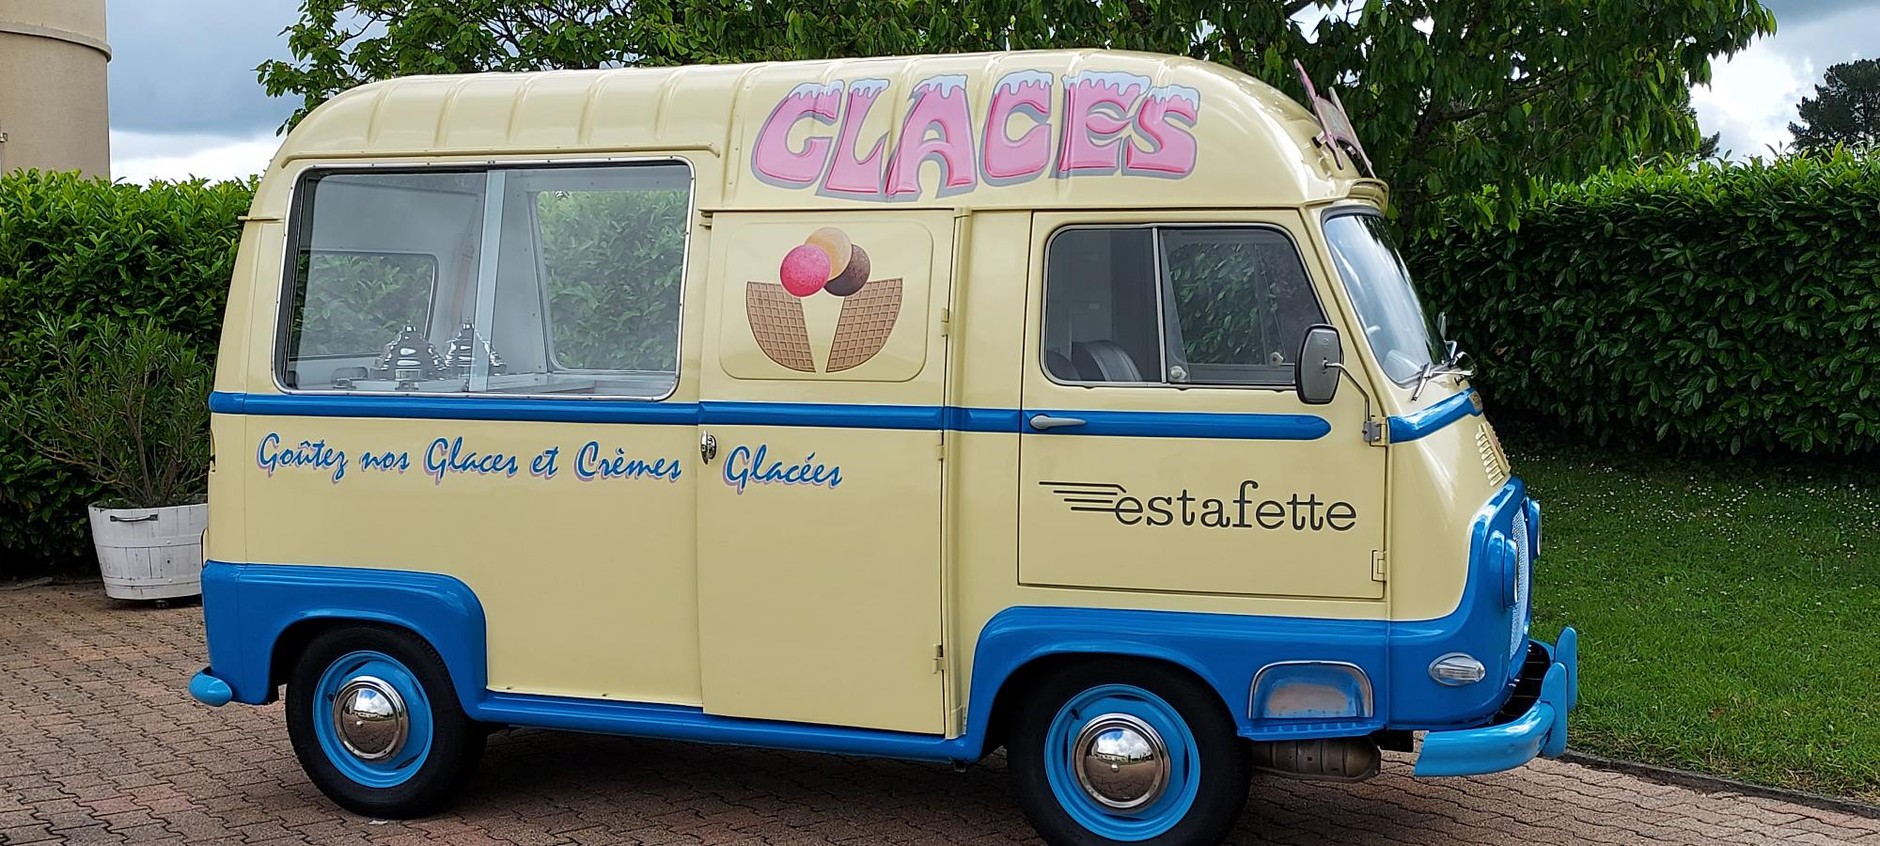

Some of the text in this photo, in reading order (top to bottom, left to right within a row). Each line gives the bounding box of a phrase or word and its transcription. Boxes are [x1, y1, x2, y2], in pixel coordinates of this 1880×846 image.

[751, 70, 1201, 202] GLACES
[257, 432, 843, 494] Goûtez nos Glaces et Crèmes Glacées
[1114, 480, 1357, 531] estafette
